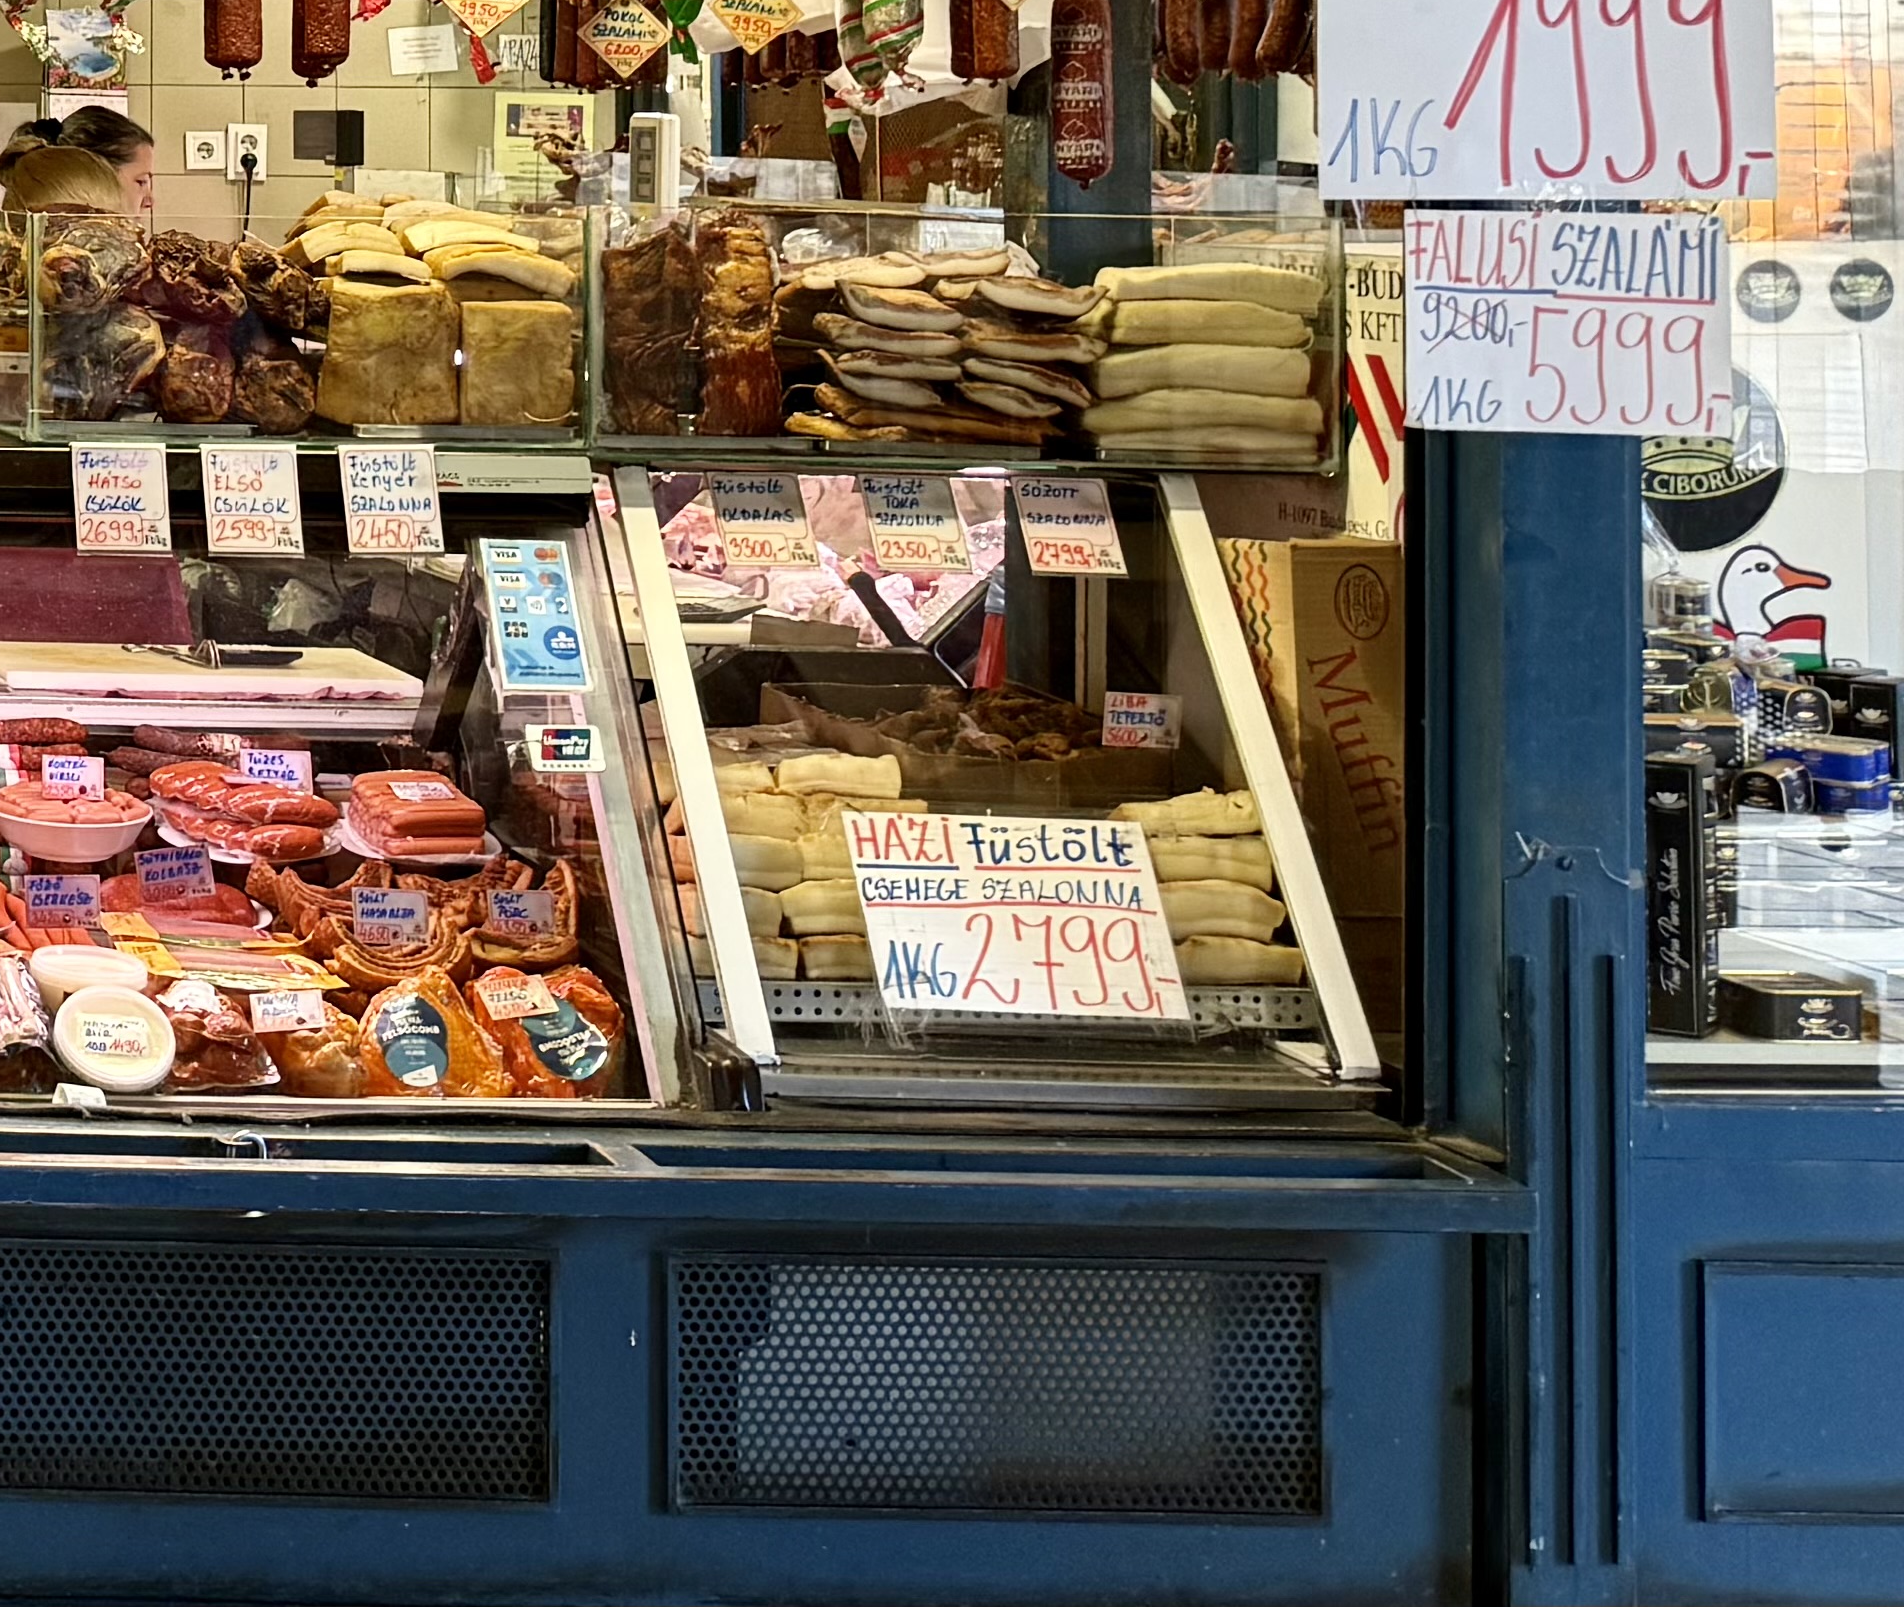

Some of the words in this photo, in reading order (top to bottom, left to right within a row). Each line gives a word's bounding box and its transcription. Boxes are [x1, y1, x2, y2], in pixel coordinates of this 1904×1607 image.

[1328, 98, 1439, 184] 1KG
[1414, 378, 1502, 425] 1KG
[1525, 305, 1732, 432] 5999,-
[851, 812, 954, 863] HÁZI
[967, 822, 1134, 869] Füstölt
[862, 879, 968, 901] CSEMEGE
[981, 880, 1144, 909] SZALONNA
[883, 940, 958, 998] 1KG
